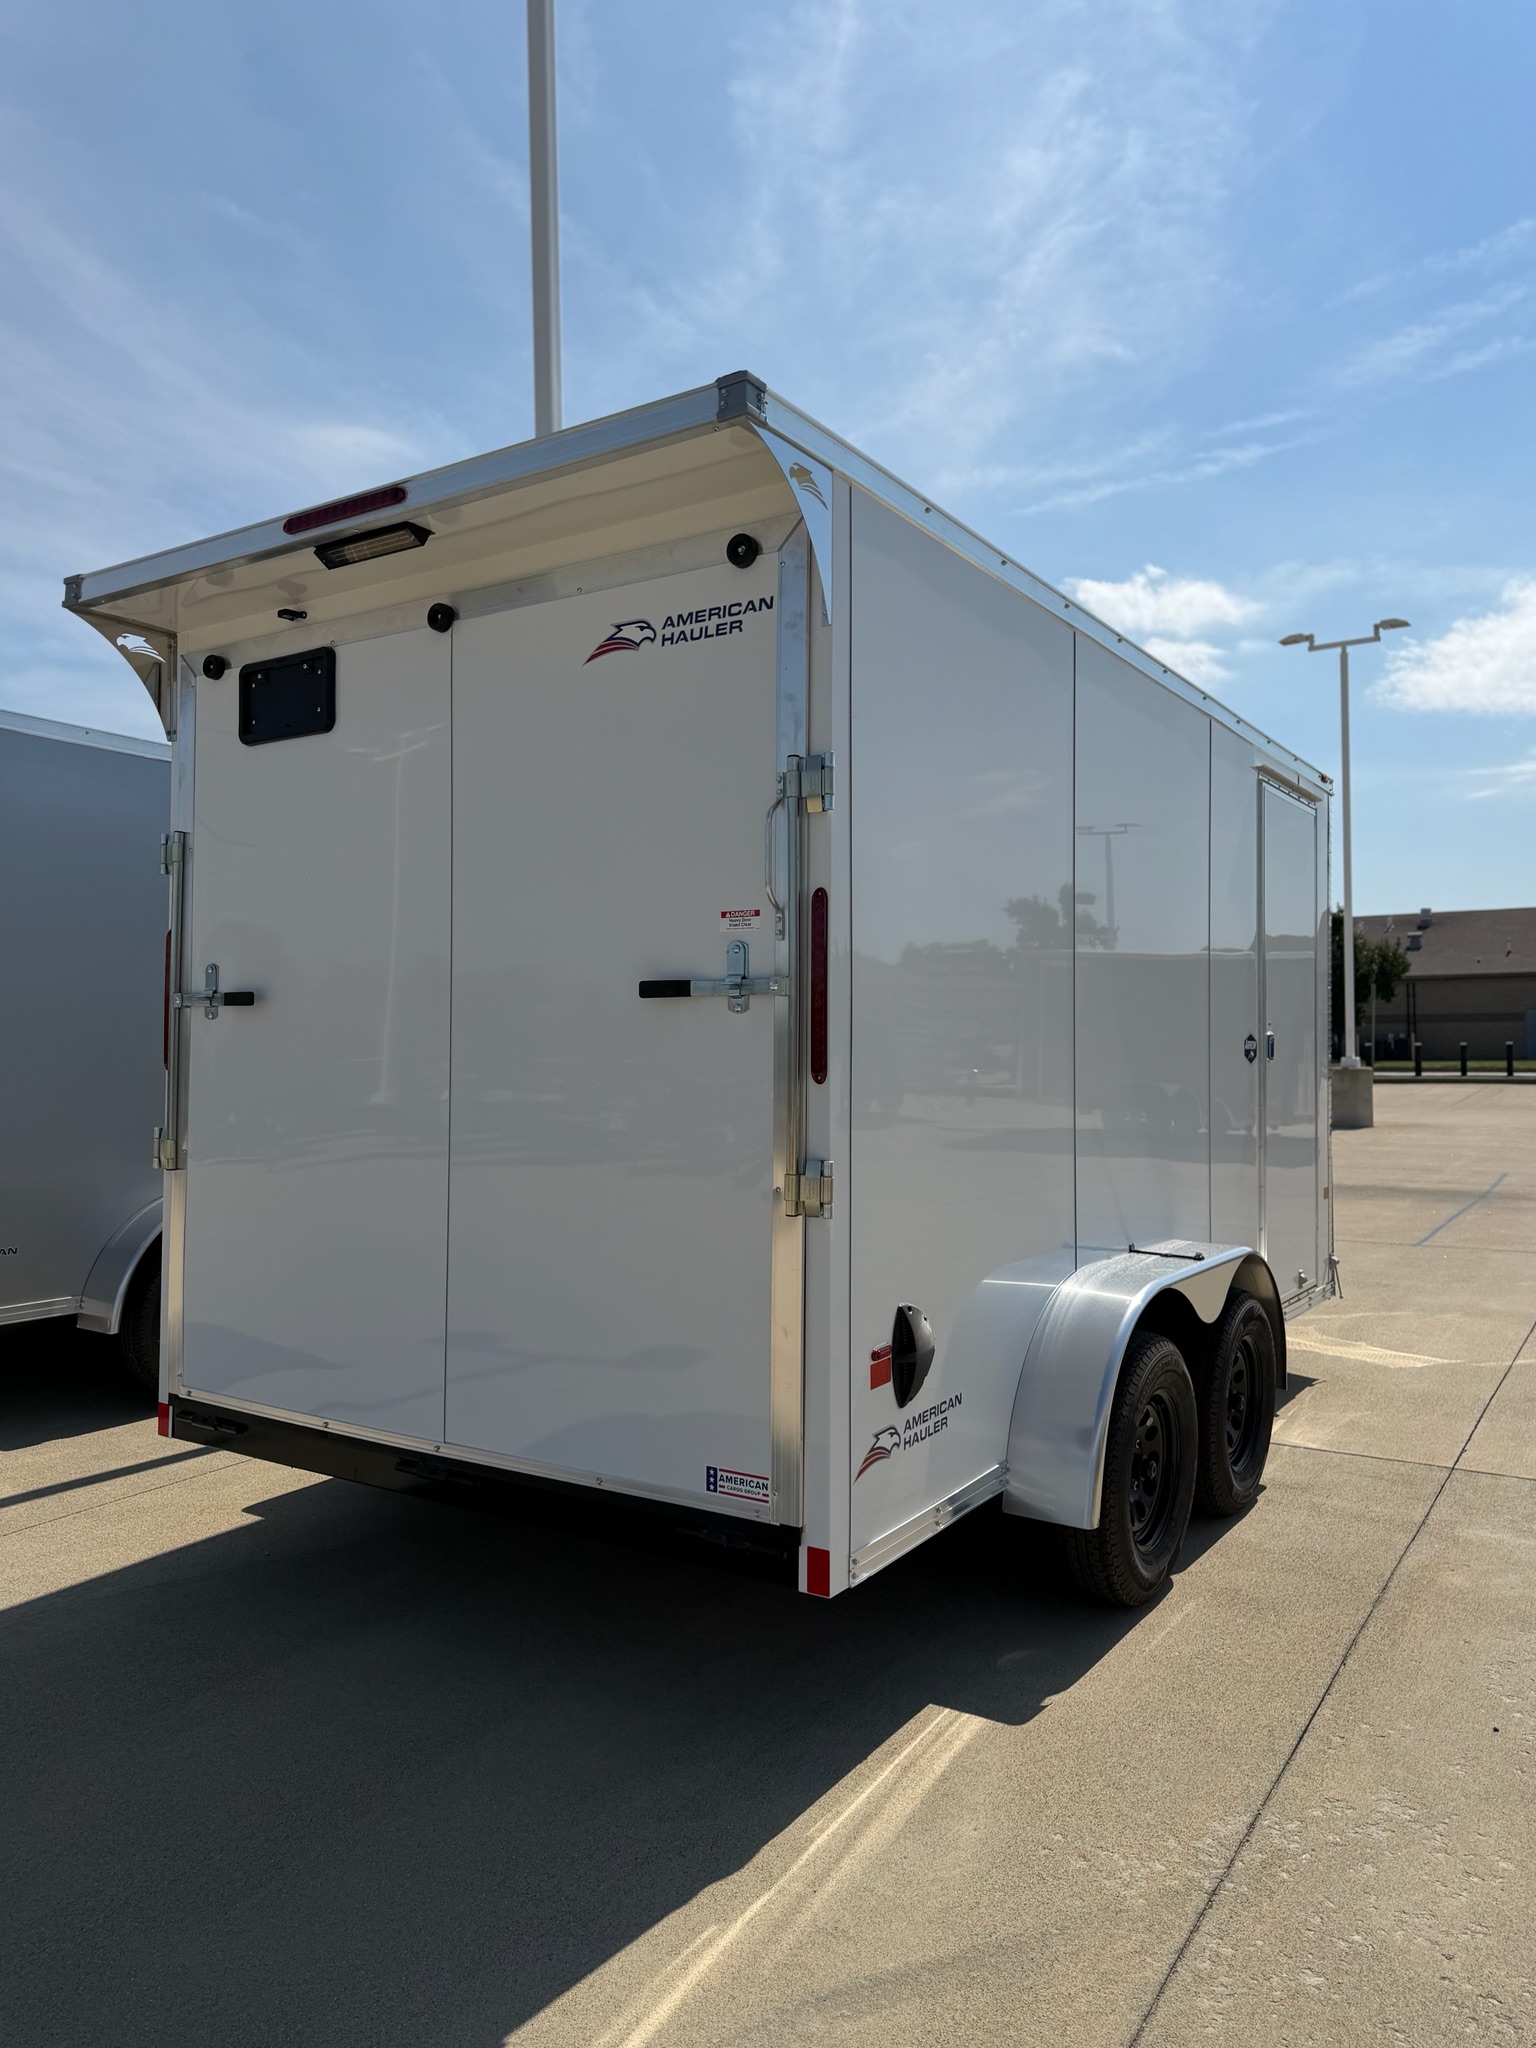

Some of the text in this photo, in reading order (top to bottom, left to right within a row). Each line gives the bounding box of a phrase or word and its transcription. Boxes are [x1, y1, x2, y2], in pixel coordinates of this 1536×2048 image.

[661, 595, 775, 630] AMERICAN
[661, 620, 743, 647] HAULER
[730, 910, 755, 918] DANGER
[903, 1392, 963, 1434] AMERICAN
[903, 1416, 949, 1451] HAULER
[718, 1474, 769, 1491] AMERICAN
[727, 1485, 761, 1496] CARGO GROUP
